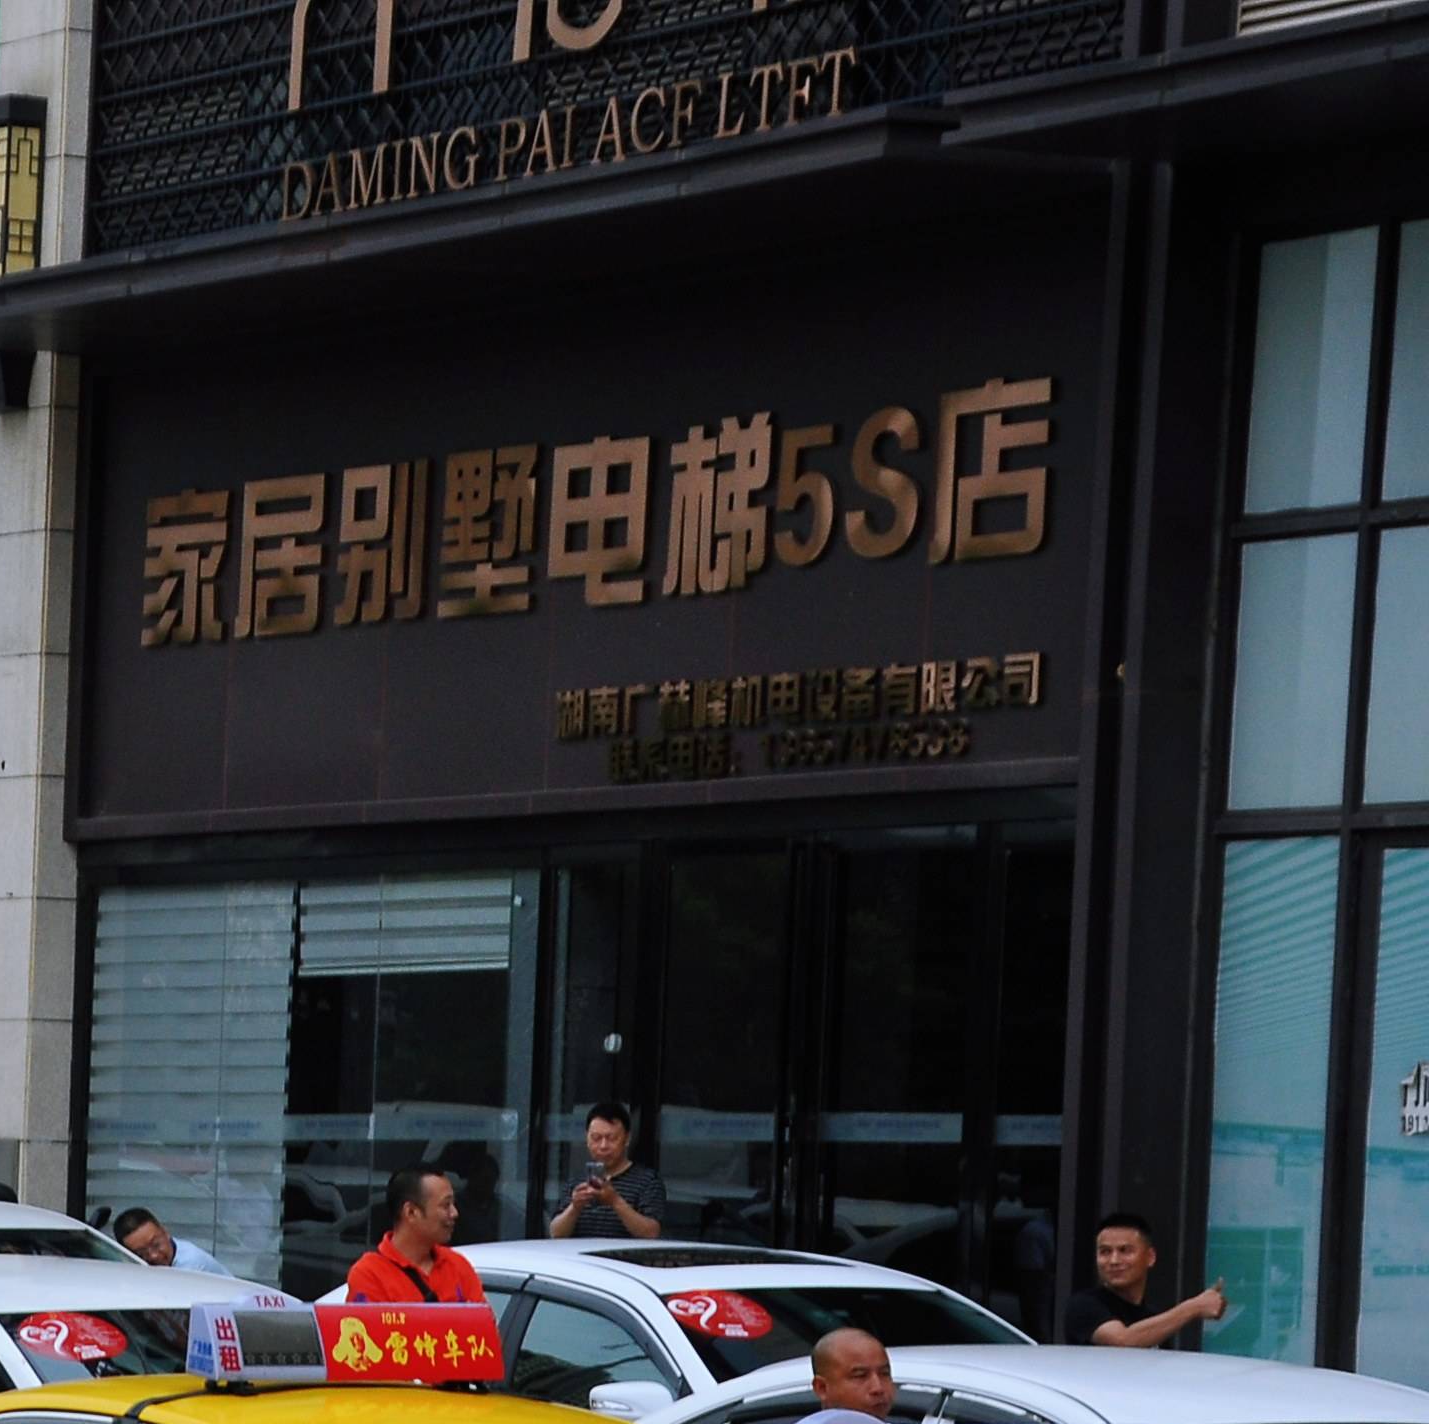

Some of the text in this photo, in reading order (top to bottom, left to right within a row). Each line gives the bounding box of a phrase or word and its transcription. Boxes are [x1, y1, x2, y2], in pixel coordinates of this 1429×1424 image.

[280, 125, 480, 221] DAMING
[141, 376, 1053, 648] 家居别墅电梯5S店
[254, 1295, 287, 1309] TAXI
[214, 1315, 242, 1373] 出租
[384, 1329, 496, 1369] 雷锋车队
